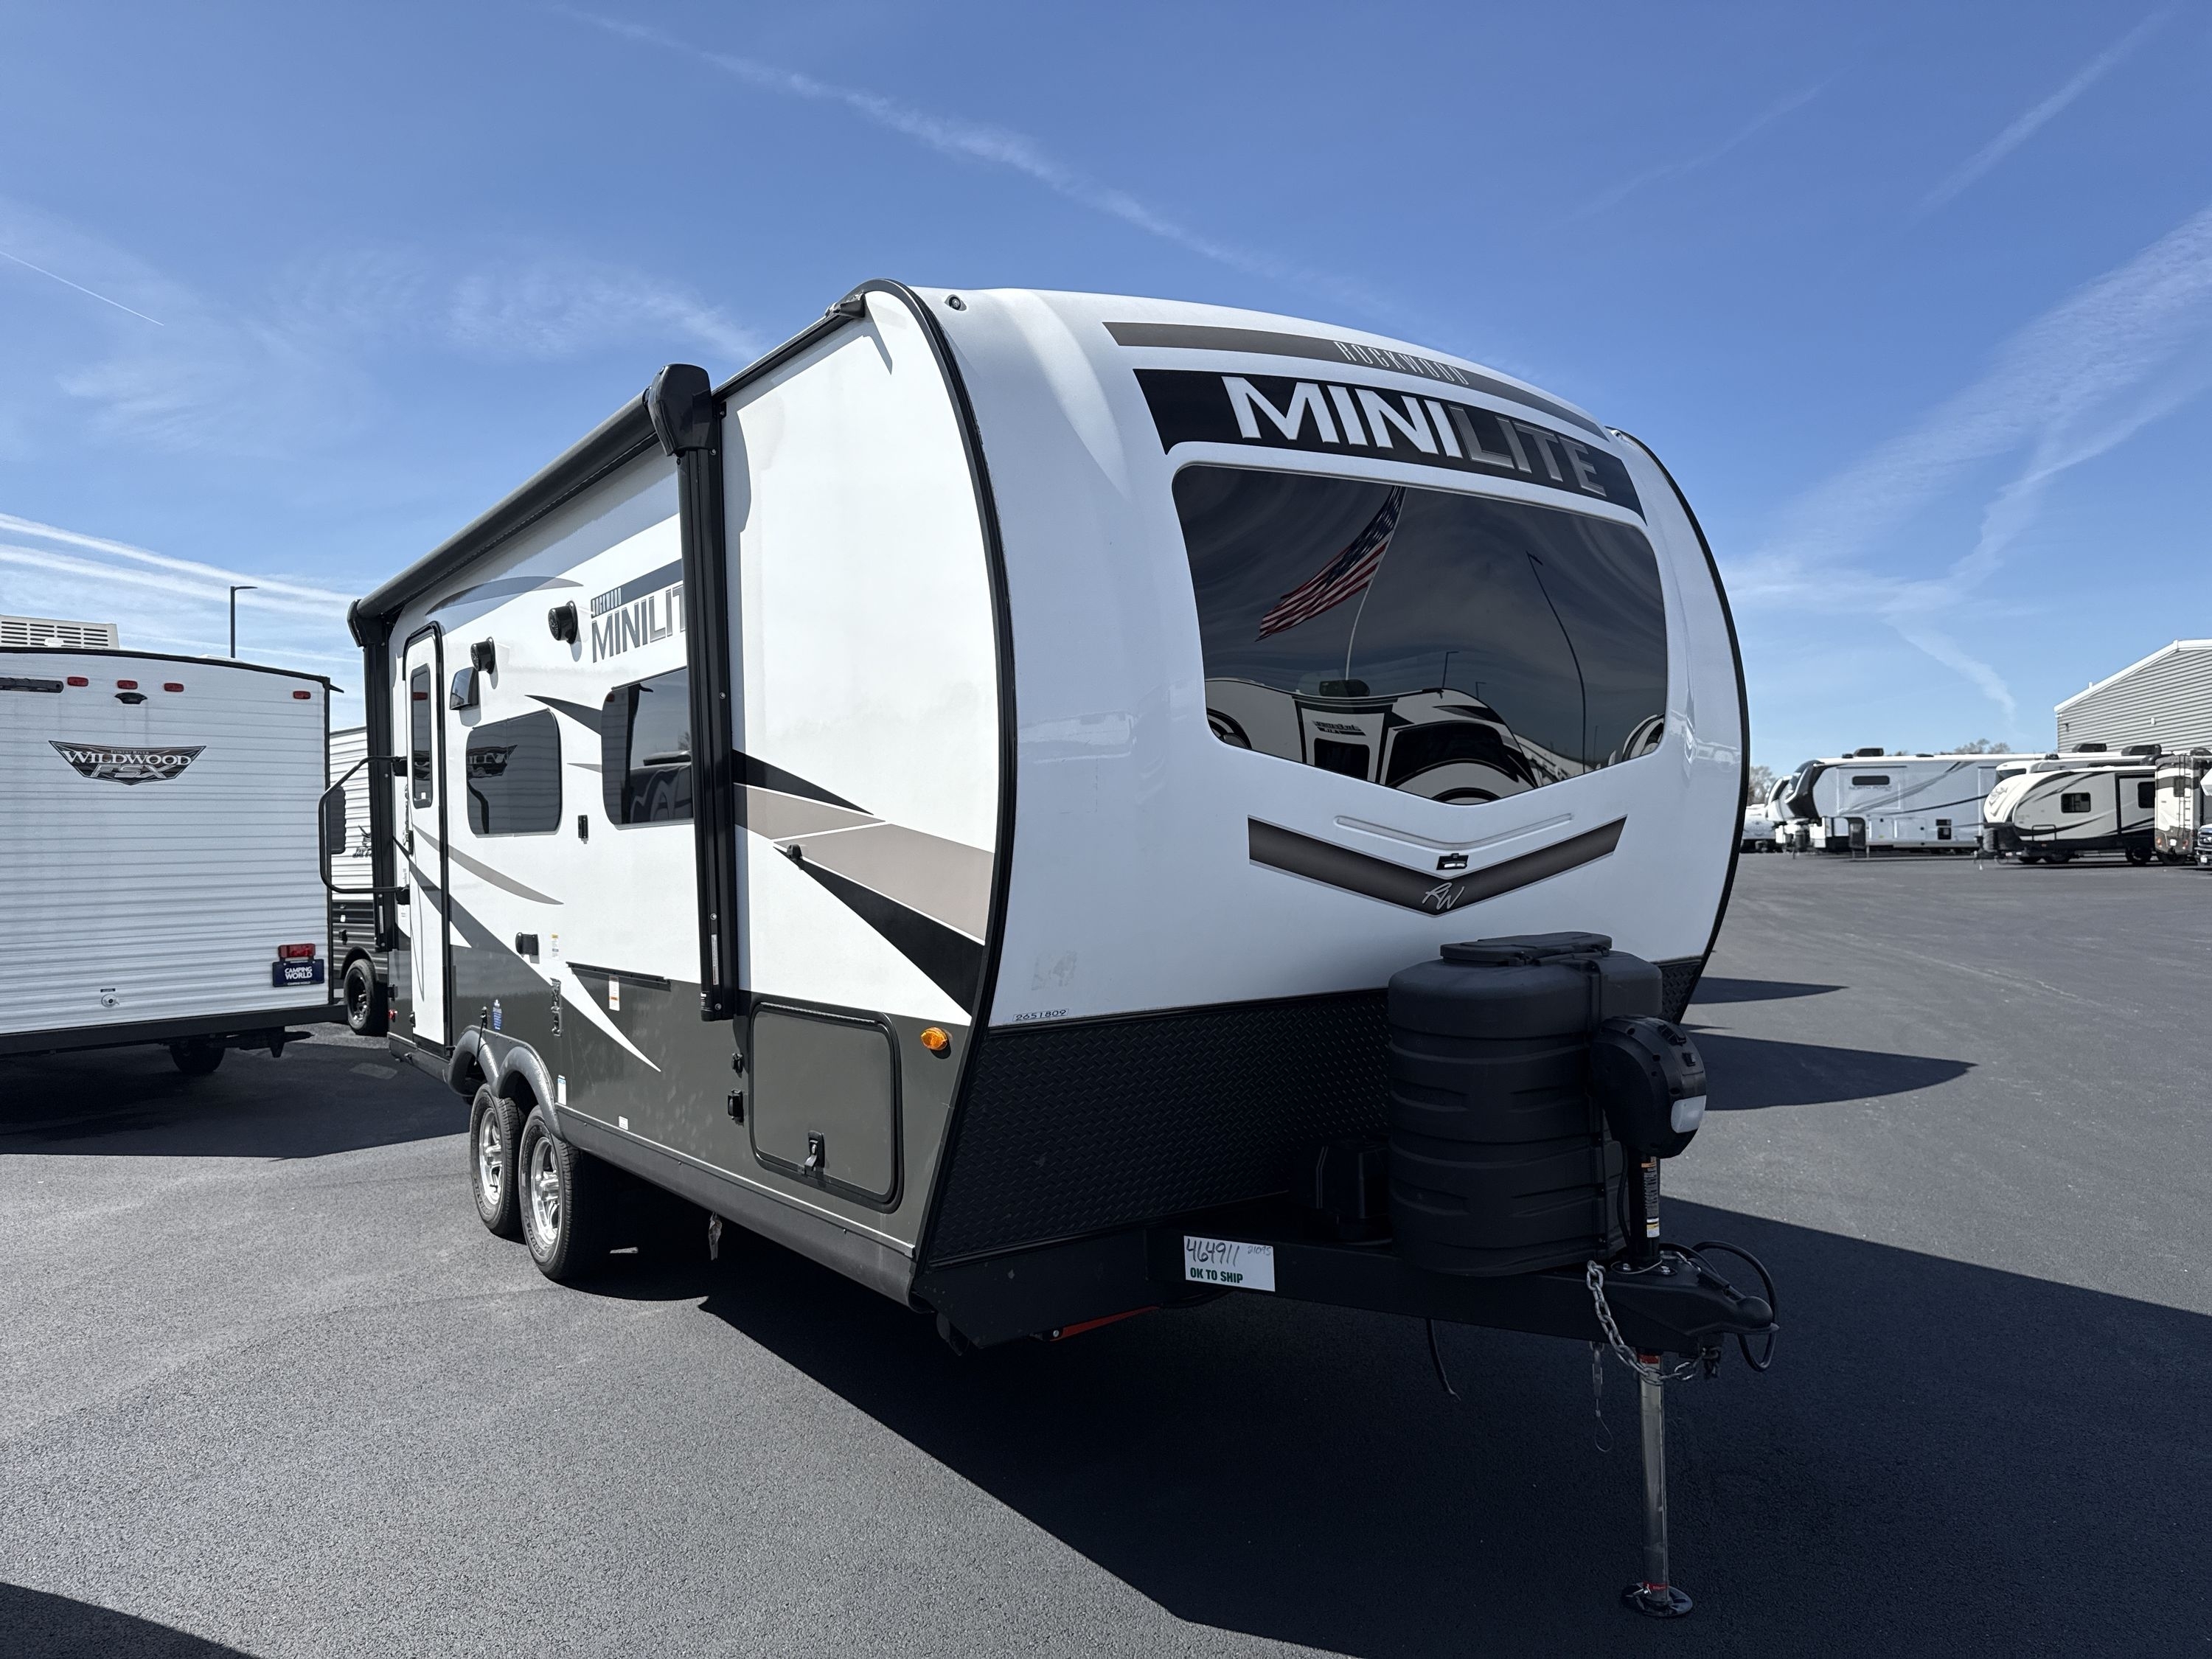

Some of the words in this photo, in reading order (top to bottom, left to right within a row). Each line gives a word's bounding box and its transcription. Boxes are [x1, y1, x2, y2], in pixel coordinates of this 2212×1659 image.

[1333, 341, 1470, 385] ROCKWOOD
[591, 584, 686, 664] MINILIT
[62, 751, 192, 765] WILDWOOD
[90, 764, 176, 779] FSX
[284, 966, 313, 974] CAMPING
[285, 971, 313, 980] WORLD
[1015, 1009, 1067, 1021] 2651809
[1186, 1238, 1239, 1267] 464911
[1190, 1267, 1203, 1279] OK
[1206, 1269, 1218, 1281] TO
[1220, 1270, 1243, 1284] SHIP
